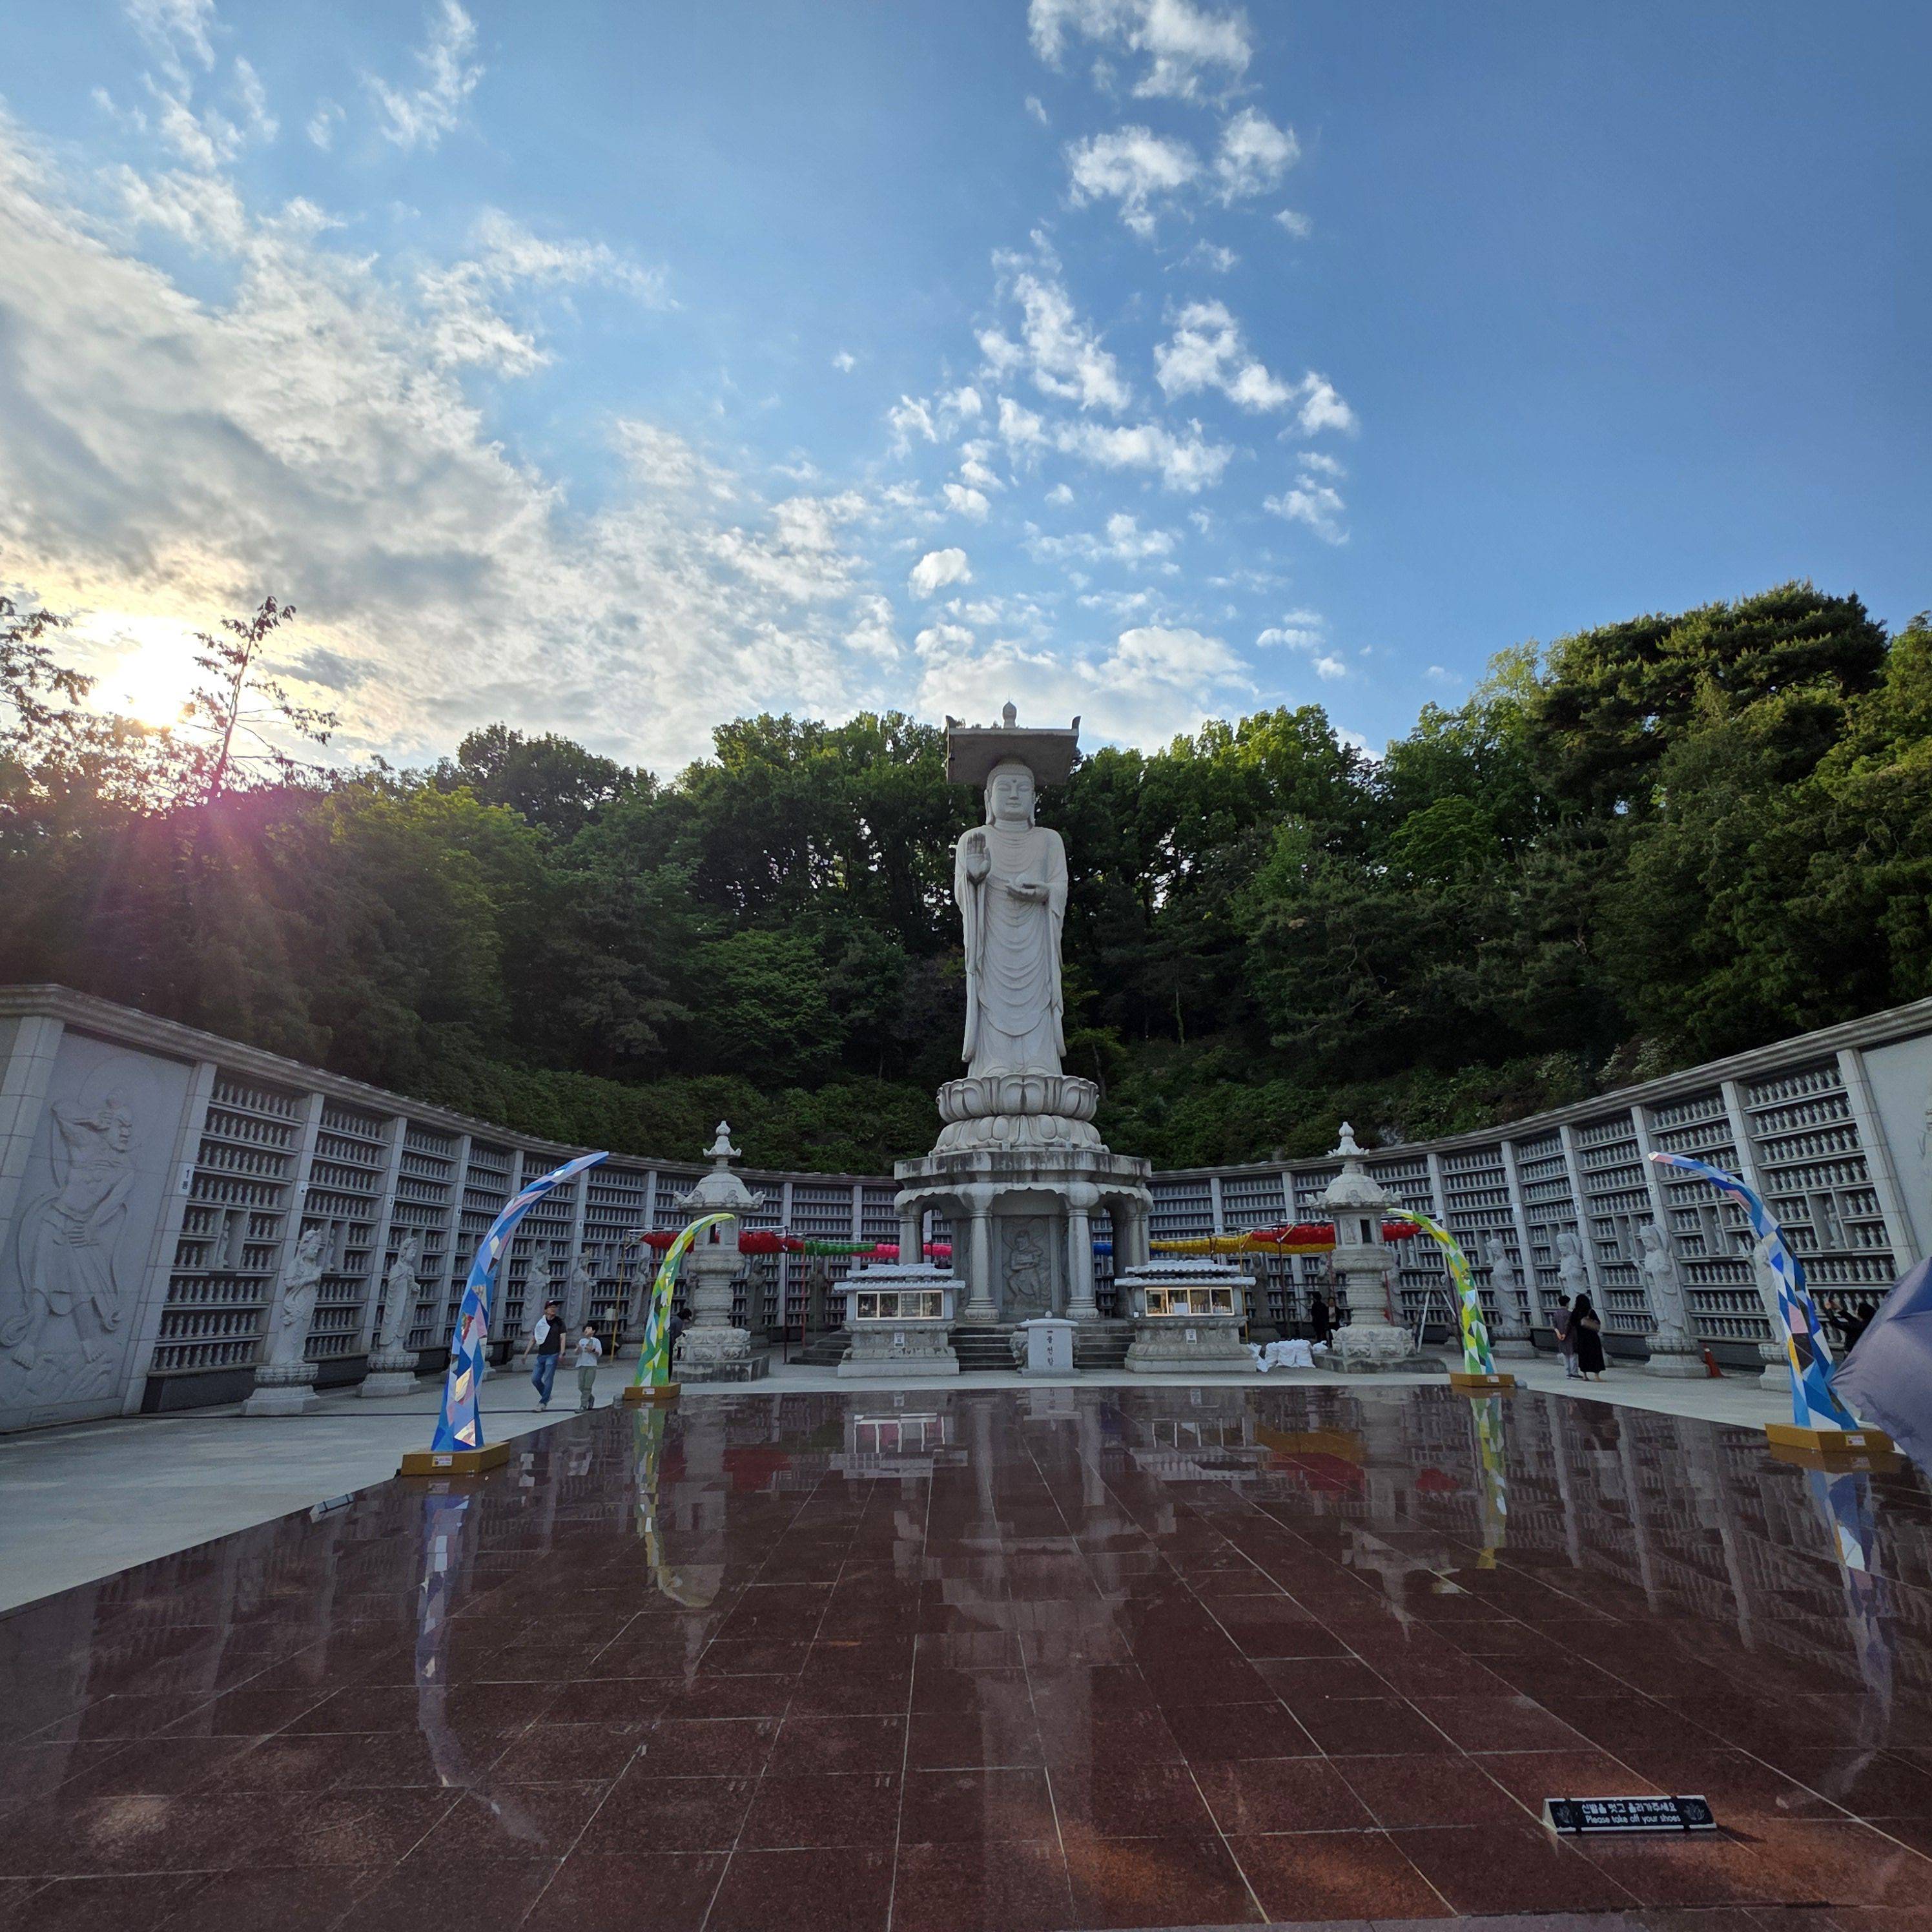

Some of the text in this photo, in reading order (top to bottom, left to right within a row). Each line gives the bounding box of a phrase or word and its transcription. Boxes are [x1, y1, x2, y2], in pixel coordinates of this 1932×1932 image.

[389, 1197, 393, 1205] 3
[1582, 1804, 1607, 1814] 신발을
[1608, 1803, 1627, 1813] 벗고
[1585, 1813, 1681, 1825] Please take off your shoes
